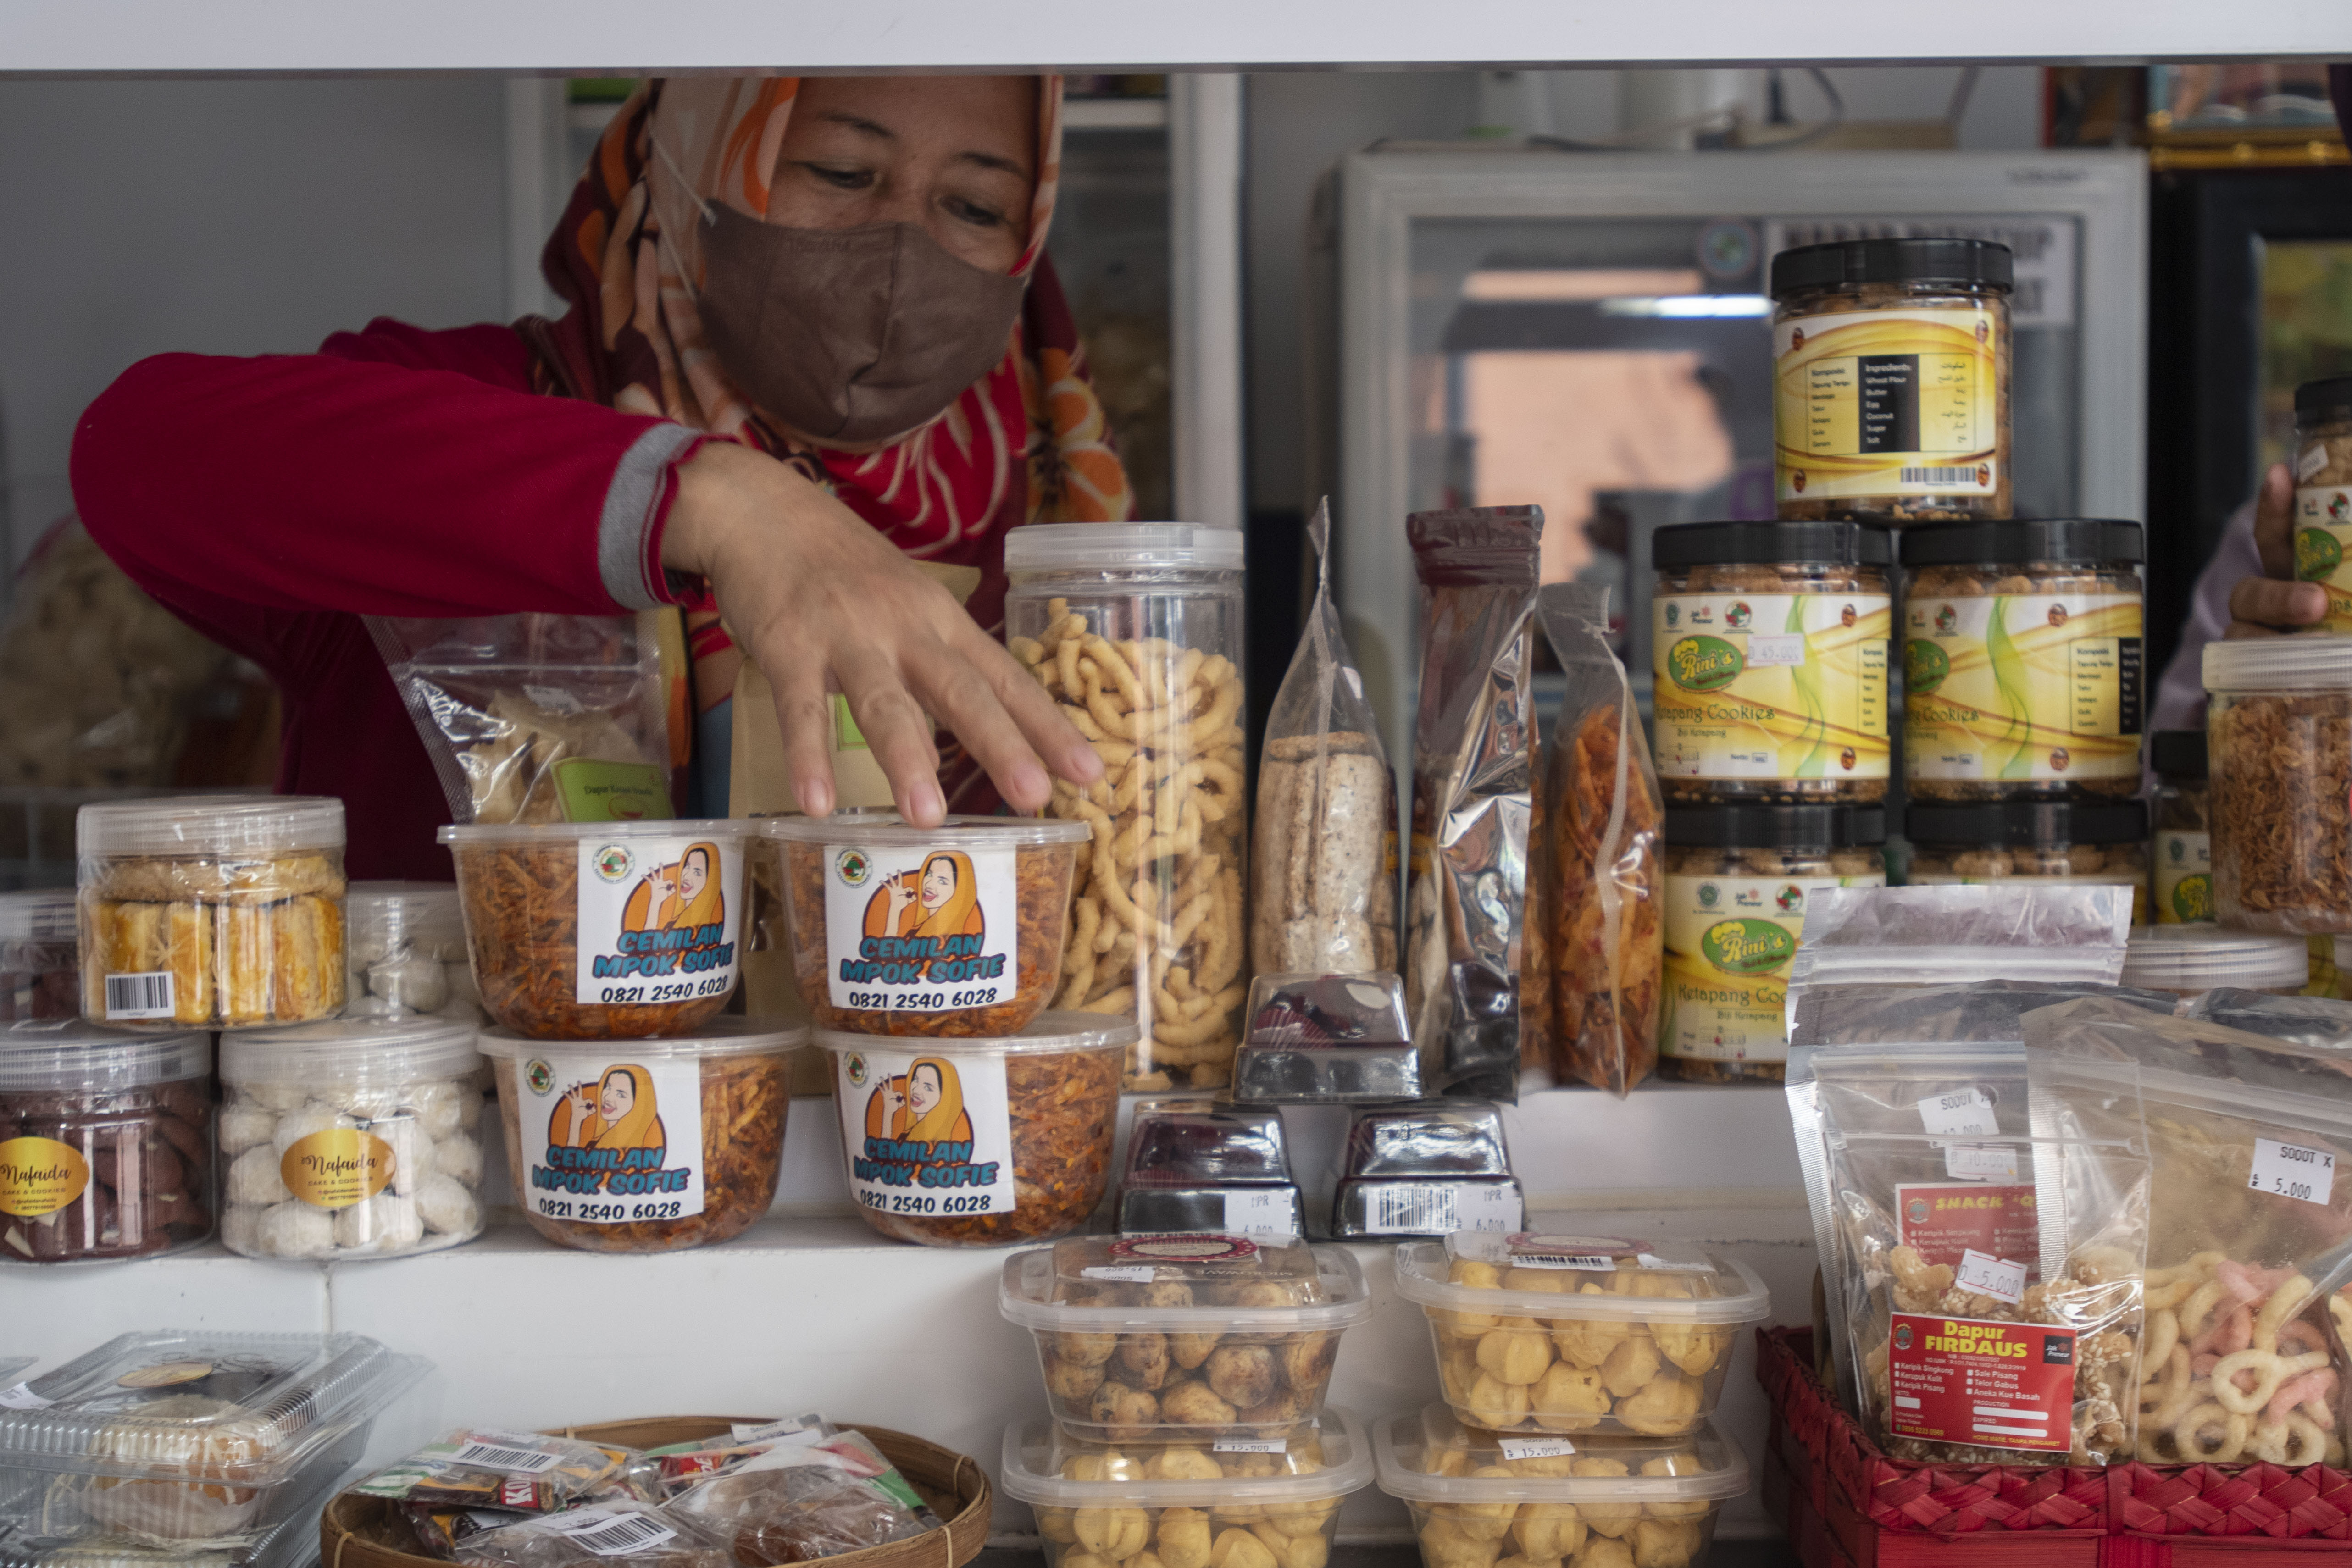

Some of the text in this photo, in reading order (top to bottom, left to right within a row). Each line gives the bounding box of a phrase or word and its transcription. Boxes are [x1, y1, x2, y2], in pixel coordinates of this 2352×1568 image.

[1707, 703, 1775, 720] Cookies
[617, 923, 724, 953] CEMILAN
[860, 933, 984, 960] CEMILAN
[593, 942, 734, 979] MPOK SOFIE
[840, 953, 1006, 985] MPOK SOFIE
[601, 975, 729, 1003] 0821 2540 6028
[849, 987, 998, 1008] 0821 2540 6028
[1679, 984, 1750, 1007] Ketapang
[546, 1145, 665, 1171] CEMILAN
[864, 1136, 973, 1163] CEMILAN
[300, 1153, 378, 1177] Nafaida
[854, 1156, 1000, 1188] MPOK SOFIE
[2323, 1156, 2332, 1168] X
[0, 1163, 72, 1187] Nafaida
[532, 1164, 692, 1196] MPOK SOFIE
[2274, 1178, 2312, 1200] 5.000
[539, 1198, 681, 1220] 0821 2540 6028
[860, 1189, 991, 1213] 0821 2540 6028
[1935, 1197, 2004, 1211] SNACK
[1476, 1219, 1505, 1232] 6.000
[1944, 1321, 2006, 1341] Dapur
[1925, 1335, 2028, 1358] FIRDAUS
[1900, 1362, 1922, 1371] Keripik
[1923, 1364, 1954, 1376] Singkong
[1992, 1371, 2018, 1381] Pisang
[1900, 1381, 1945, 1394] Keripik Pisang
[1974, 1379, 2019, 1389] Telor Gabus
[1974, 1388, 1997, 1397] Aneka
[2015, 1392, 2041, 1401] Basah
[1522, 1447, 1560, 1457] 15.000
